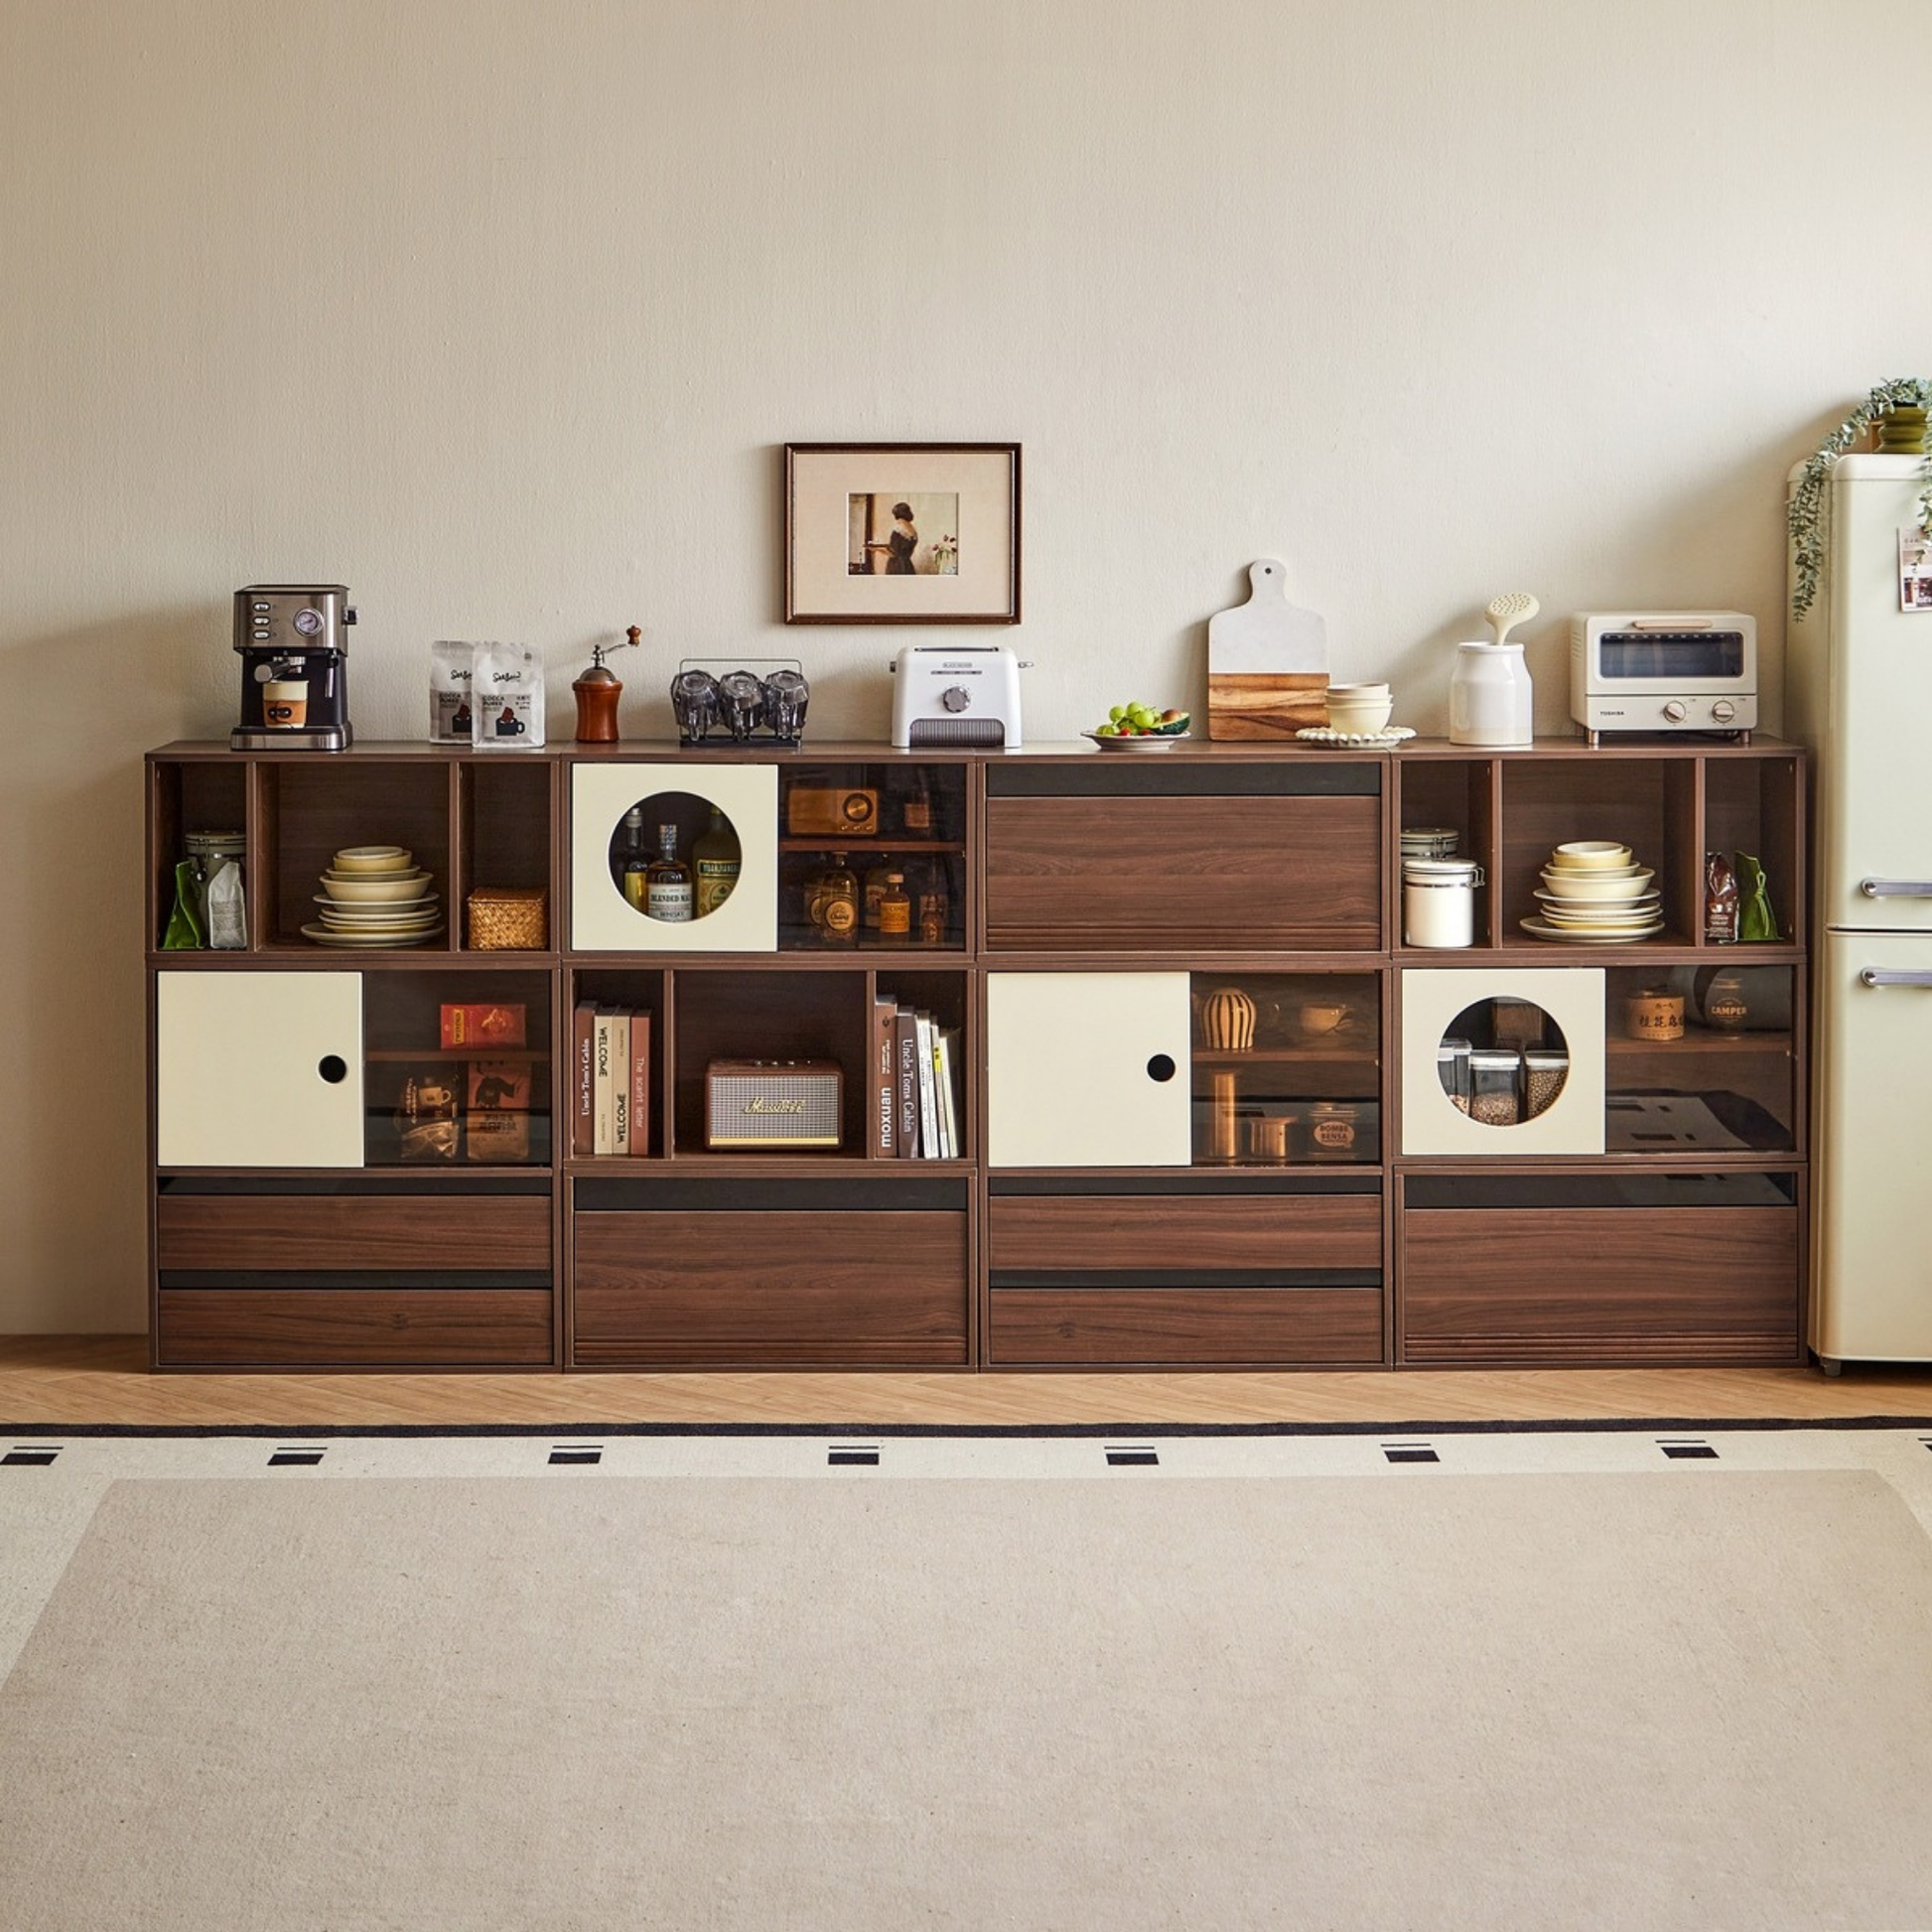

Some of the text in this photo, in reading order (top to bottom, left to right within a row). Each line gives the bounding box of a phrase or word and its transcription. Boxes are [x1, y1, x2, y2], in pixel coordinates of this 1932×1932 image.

[599, 1027, 608, 1077] WELCOME
[635, 1057, 644, 1073] The
[901, 1038, 913, 1071] Uncle
[617, 1094, 626, 1144] WELCOME
[881, 1087, 892, 1148] moxuan
[903, 1101, 915, 1133] Cabin
